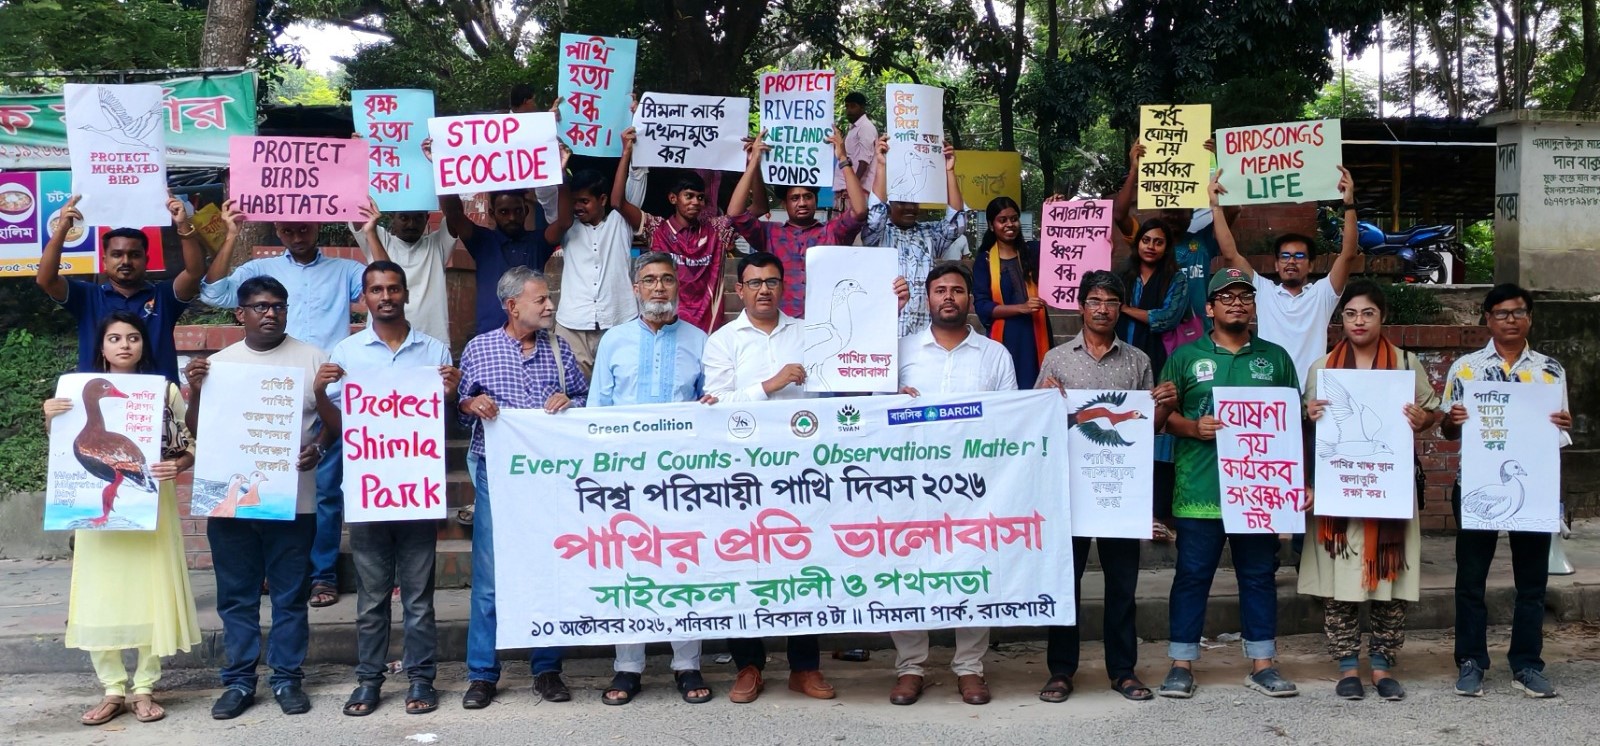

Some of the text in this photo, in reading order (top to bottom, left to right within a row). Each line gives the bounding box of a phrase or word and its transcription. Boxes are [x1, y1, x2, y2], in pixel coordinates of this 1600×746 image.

[565, 36, 615, 65] পাখি
[567, 64, 614, 90] হত্যা
[764, 73, 835, 94] PROTECT
[363, 94, 398, 120] বৃক্ষ
[567, 91, 602, 122] বন্ধ
[640, 96, 727, 121] সিমলা পার্ক
[764, 99, 826, 121] RIVERS
[367, 122, 414, 143] হত্যা
[447, 117, 520, 148] STOP
[762, 125, 834, 145] WETLANDS
[1225, 123, 1324, 155] BIRDSONGS
[90, 152, 150, 163] PROTECT
[252, 140, 346, 165] PROTECT
[369, 145, 401, 168] বন্ধ
[657, 145, 690, 165] কর
[763, 145, 819, 167] TREES
[1241, 150, 1304, 175] MEANS
[1552, 156, 1576, 170] দান
[91, 163, 160, 175] MIGRATED
[261, 166, 320, 189] BIRDS
[439, 146, 549, 188] ECOCIDE
[768, 165, 820, 185] PONDS
[108, 175, 140, 185] BIRD
[1247, 172, 1304, 199] LIFE
[239, 193, 347, 216] HABITATS.
[1054, 263, 1077, 282] বন্ধ
[1051, 286, 1080, 304] কর
[838, 350, 867, 364] পাখির
[838, 366, 890, 378] ভালোবাসা
[345, 383, 442, 419] Protect
[1473, 390, 1511, 404] পাখির
[939, 404, 982, 418] BARCIK
[587, 418, 693, 435] Green Coalition
[838, 424, 860, 433] SWAN
[344, 426, 441, 461] Shimla
[509, 454, 584, 480] Every
[593, 451, 647, 472] Bird
[813, 441, 951, 467] Observations
[574, 465, 987, 513] বিশ্ব পরিযায়ী পাখি দিবস ২০২৬
[553, 507, 1046, 574] পাখির প্রতি ভালোবাসা
[588, 572, 741, 614] সাইকেল
[841, 574, 868, 598] ও
[873, 565, 993, 596] পথসভা
[531, 620, 554, 637] ১০
[559, 615, 624, 637] অক্টোবর
[675, 611, 733, 633] শনিবার
[754, 607, 812, 629] বিকাল
[867, 600, 925, 624] সিমলা
[976, 593, 1057, 620] রাজশাহী
